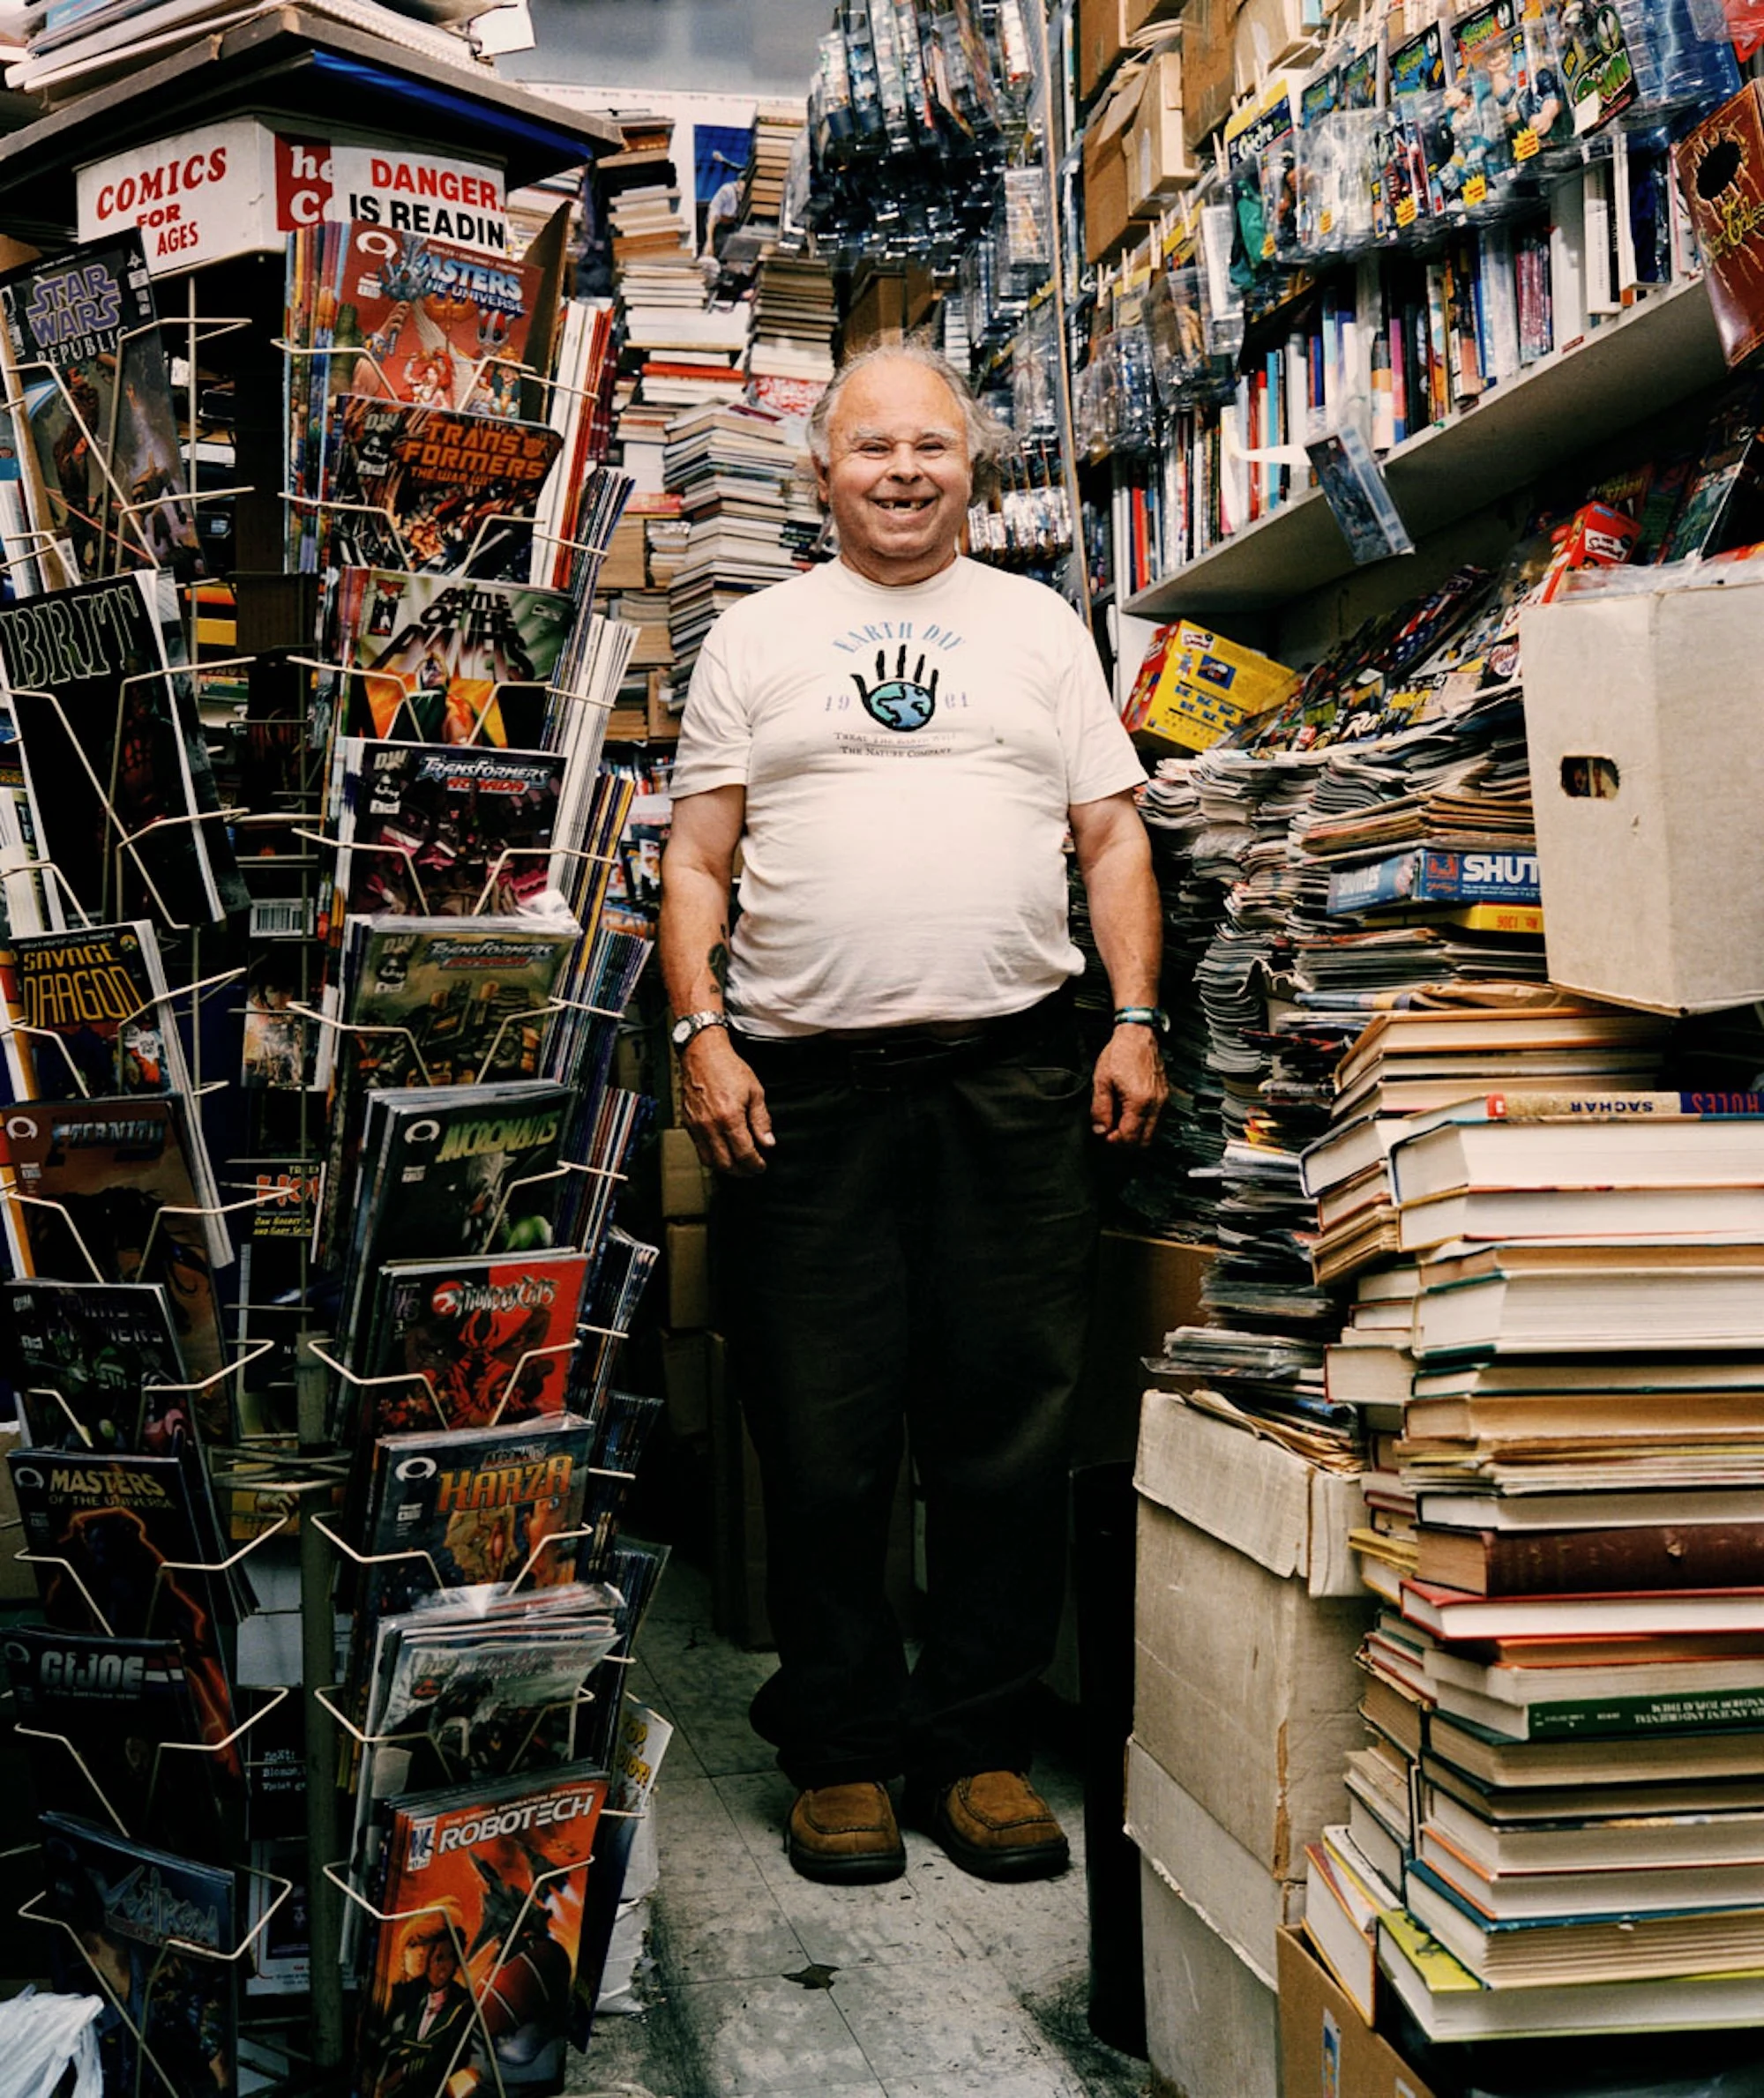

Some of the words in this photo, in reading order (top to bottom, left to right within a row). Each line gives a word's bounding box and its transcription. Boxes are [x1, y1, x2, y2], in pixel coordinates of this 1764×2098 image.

[96, 146, 226, 220] COMICS
[371, 159, 505, 213] DANGER.
[137, 204, 180, 228] FOR
[350, 194, 380, 224] IS
[390, 200, 504, 249] READIN
[157, 221, 198, 257] AGES
[26, 264, 118, 317] STAR
[452, 286, 525, 313] UNIVERSE
[29, 292, 122, 348] WARS
[427, 420, 521, 455] TRANS
[403, 442, 547, 479] FORMERS
[411, 466, 435, 481] THE
[833, 622, 912, 653] EARTH
[923, 624, 965, 651] DAY
[840, 746, 863, 757] THE
[907, 747, 952, 758] COMPANY
[1462, 855, 1541, 885] SHUT
[23, 942, 120, 972] SAVAGE
[24, 966, 145, 1028] DRAGON
[1571, 1101, 1653, 1113] SACHAR
[435, 1112, 561, 1163] MICRONAUTS
[49, 1495, 68, 1505] OF
[73, 1495, 100, 1506] THE
[50, 1469, 166, 1497] MASTERS
[438, 1795, 594, 1853] ROBOTECH
